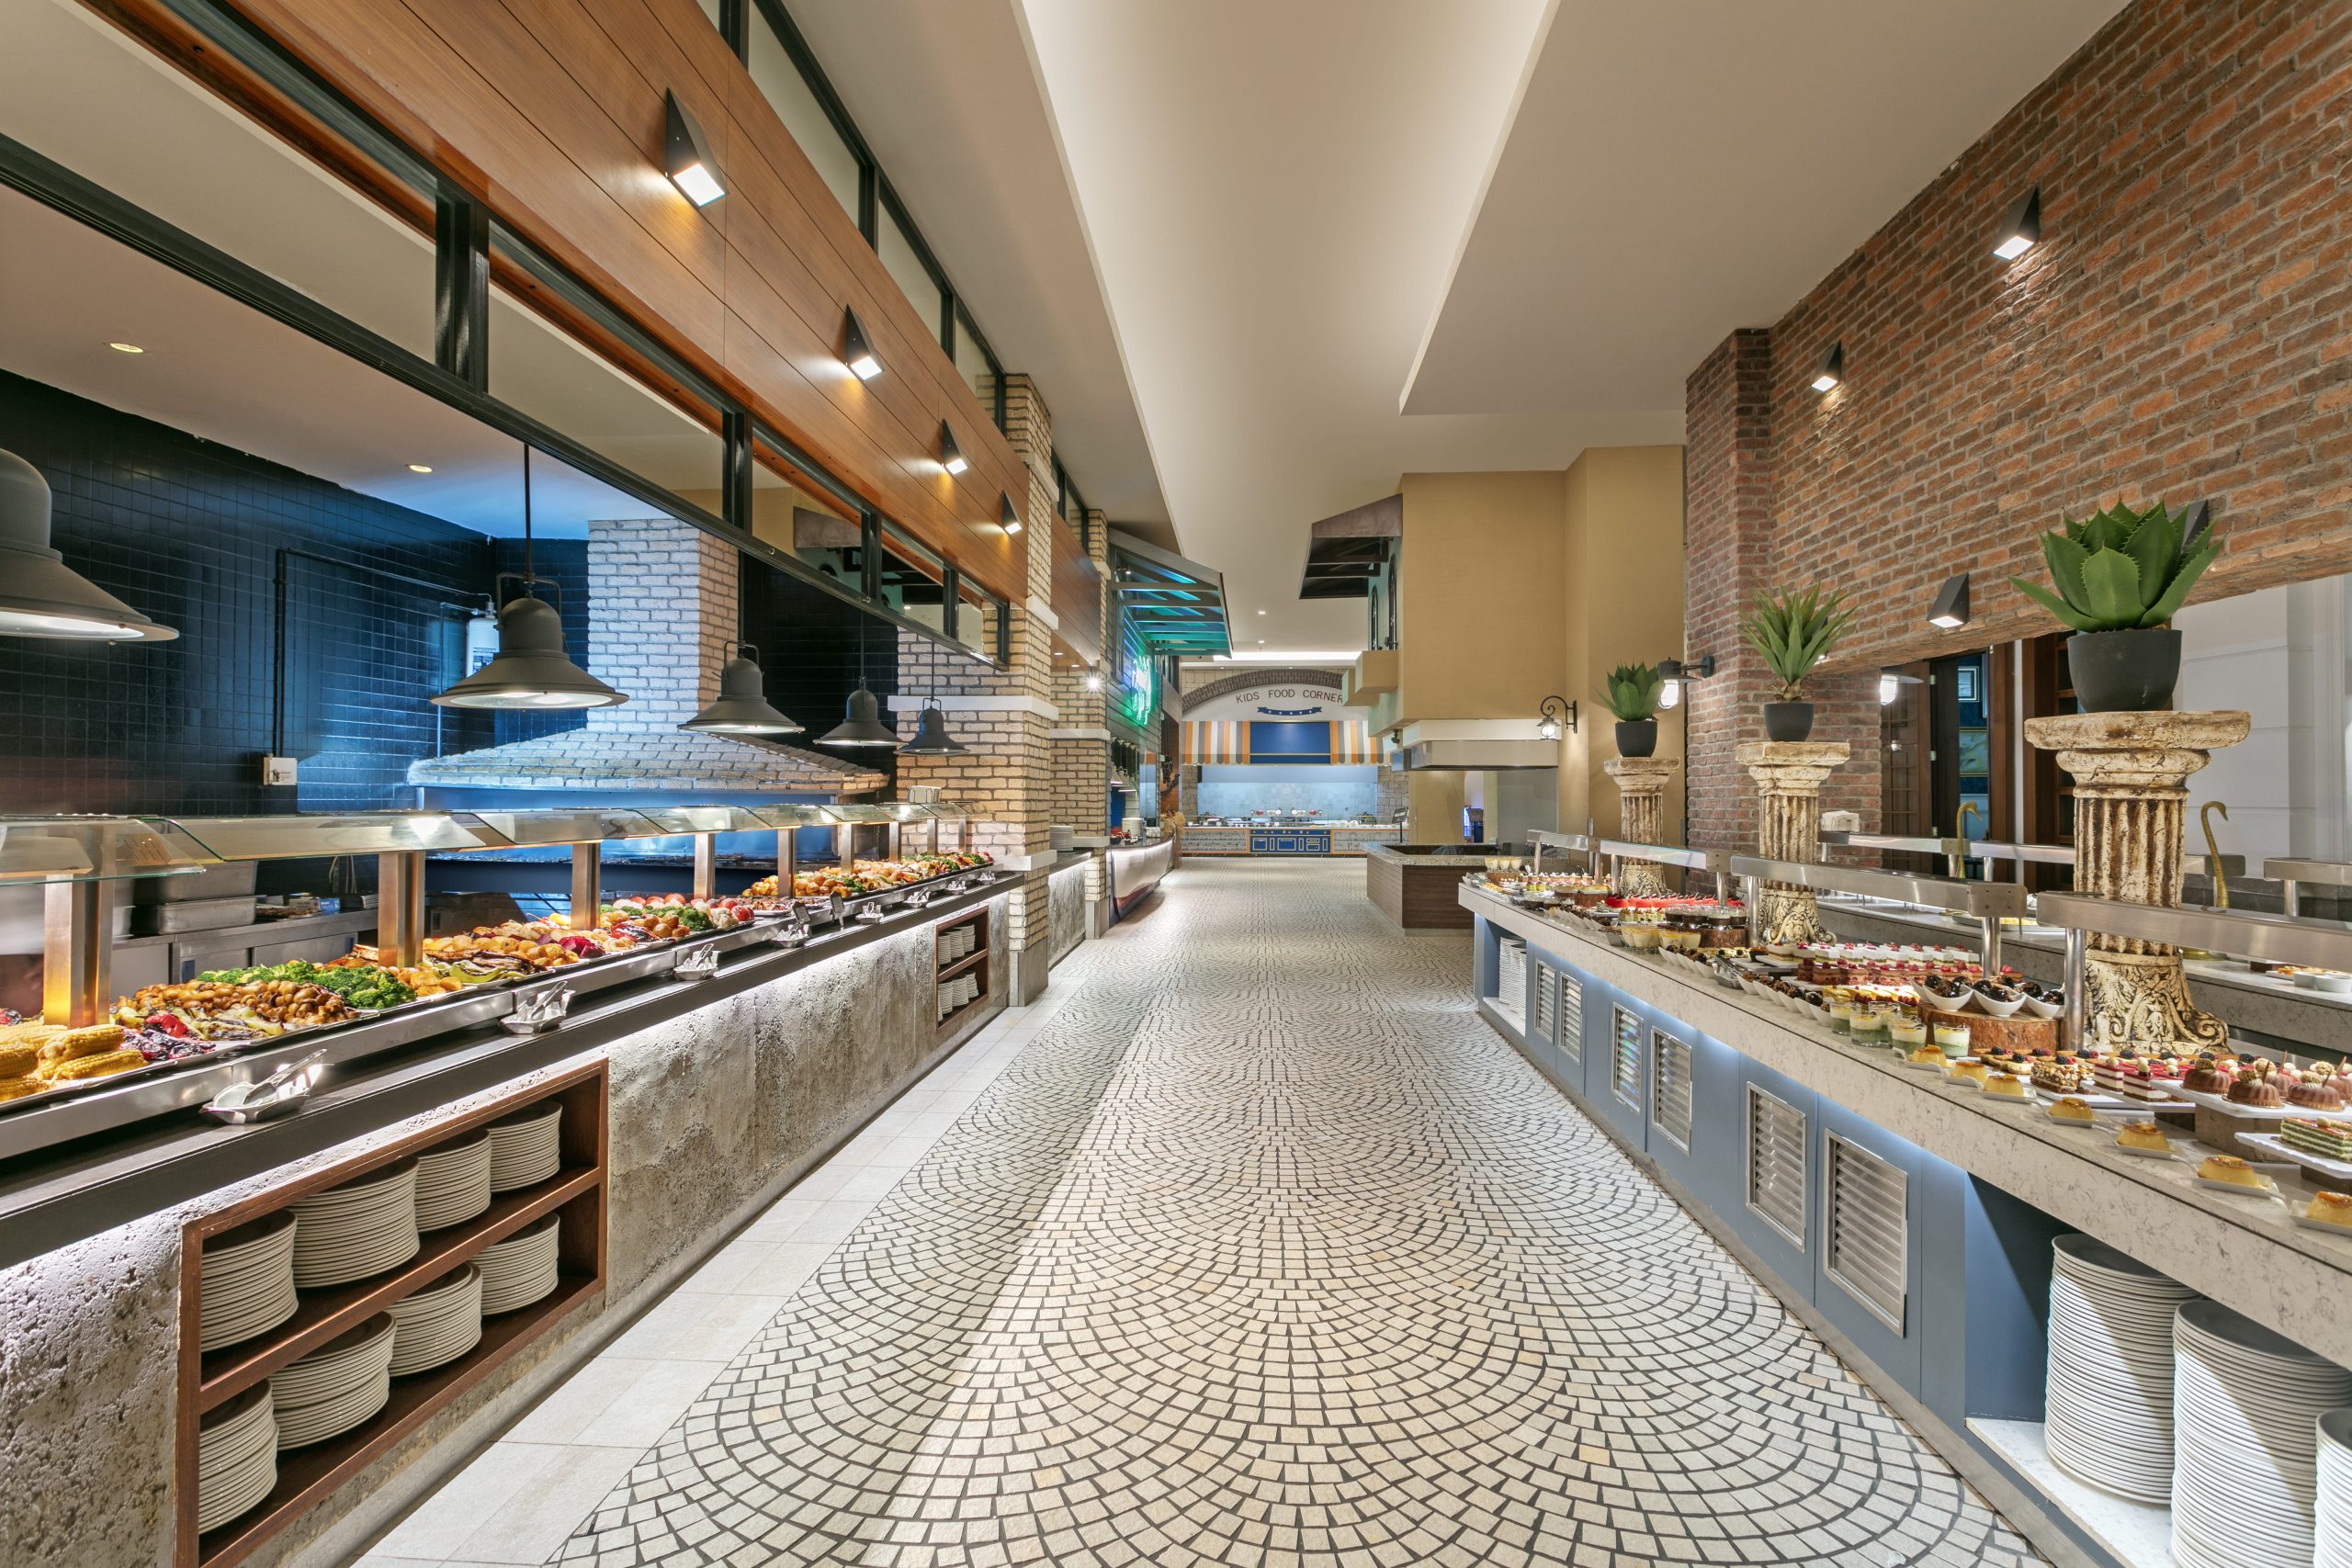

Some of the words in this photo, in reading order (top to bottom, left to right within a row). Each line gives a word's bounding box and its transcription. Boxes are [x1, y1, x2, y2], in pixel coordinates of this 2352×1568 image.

[1236, 692, 1260, 704] KIDS
[1268, 689, 1295, 698] FOOD
[1303, 690, 1342, 703] CORNER
